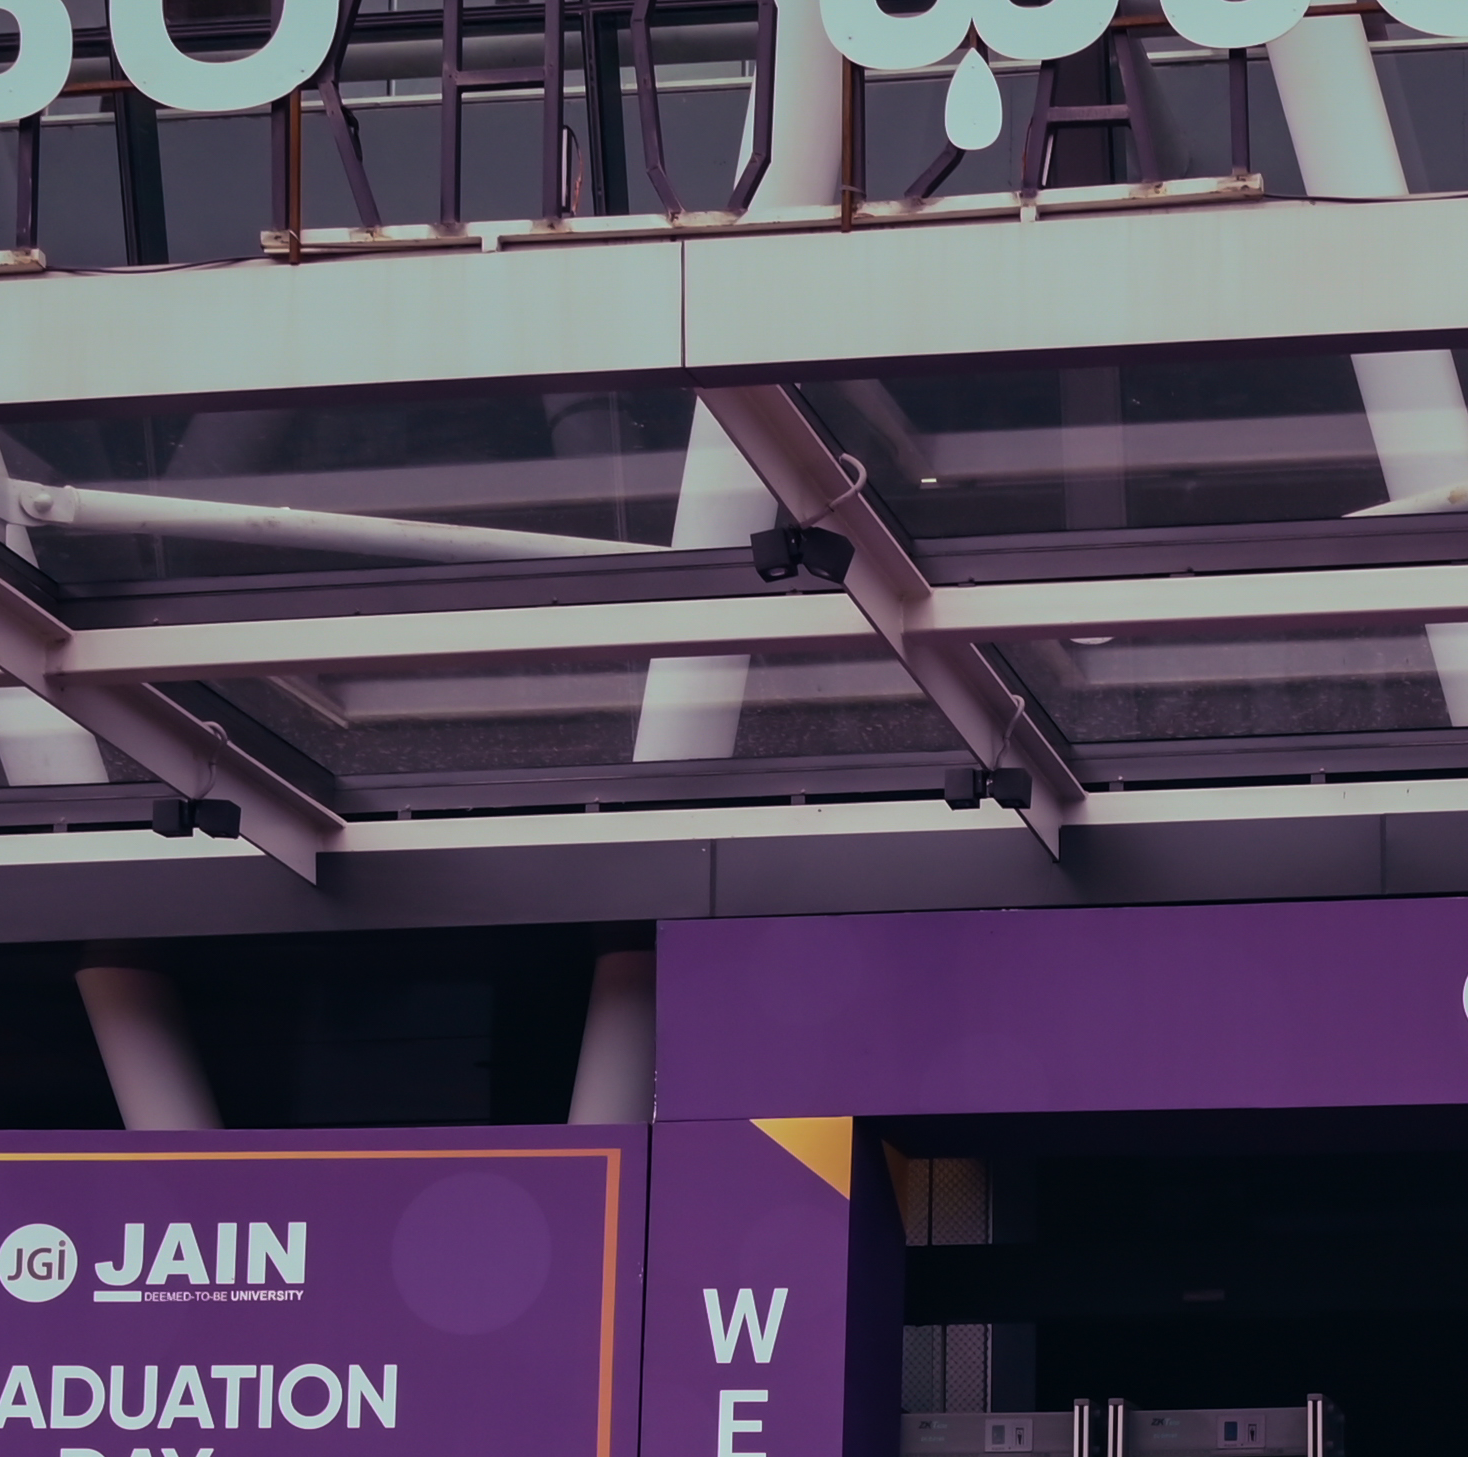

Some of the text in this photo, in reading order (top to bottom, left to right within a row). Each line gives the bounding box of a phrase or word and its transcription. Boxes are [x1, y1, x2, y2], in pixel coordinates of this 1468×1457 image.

[94, 1221, 308, 1286] JAIN
[144, 1289, 304, 1302] DEEMED-TO-BE UNIVERSITY
